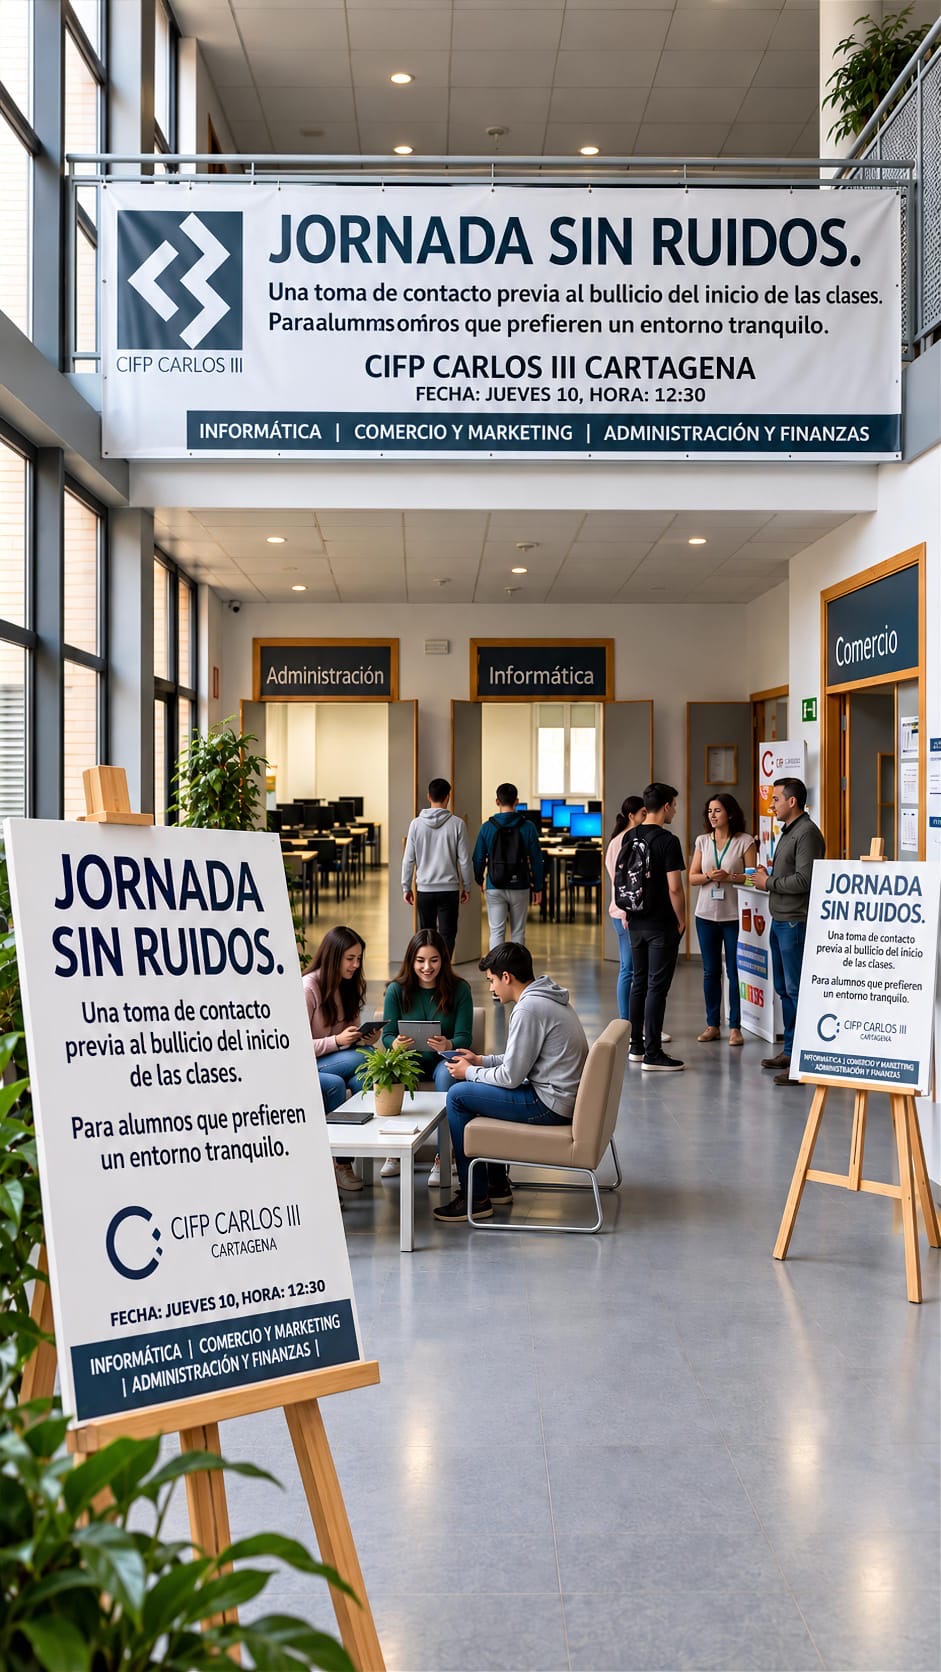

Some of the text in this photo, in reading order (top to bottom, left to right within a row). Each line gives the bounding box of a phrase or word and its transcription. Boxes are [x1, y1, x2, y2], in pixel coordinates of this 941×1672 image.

[269, 214, 861, 267] JORNADA SIN RUIDOS.
[269, 282, 882, 307] Una toma de contacto previa al bullicio del inicio de las clases.
[465, 319, 501, 337] que
[508, 314, 602, 337] prefieren
[609, 320, 634, 333] un
[640, 317, 723, 333] entorno
[728, 315, 829, 339] tranquilo.
[117, 356, 242, 373] CIFP CARLOS III
[365, 354, 756, 379] CIFP CARLOS III CARTAGENA
[416, 386, 705, 404] FECHA: JUEVES 10, HORA: 12:30
[200, 420, 322, 439] INFORMÁTICA
[355, 424, 447, 439] COMERCIO
[452, 425, 463, 440] Y
[469, 425, 572, 440] MARKETING
[604, 422, 759, 441] ADMINISTRACIÓN
[764, 426, 775, 441] Y
[781, 426, 869, 441] FINANZAS
[836, 625, 897, 666] Comercio
[267, 666, 383, 684] Administración
[490, 665, 593, 684] Informática
[55, 854, 264, 912] JORNADA
[825, 873, 922, 896] JORNADA
[820, 900, 925, 923] SIN RUIDOS.
[828, 930, 915, 944] Una toma de contacto
[52, 926, 284, 977] SIN RUIDOS.
[816, 944, 923, 958] previa al bullicio del inicio
[843, 957, 895, 969] de las clases.
[812, 975, 922, 991] Para alumnos que prefieren
[836, 991, 868, 1000] entorno
[870, 994, 909, 1004] tranquilo.
[82, 999, 270, 1023] Una toma de contacto
[844, 1020, 861, 1031] CIFP
[863, 1021, 897, 1034] CARLOS
[66, 1028, 289, 1064] previa al bullicio del inicio
[130, 1062, 242, 1087] de las clases.
[72, 1104, 306, 1139] Para alumnos que prefieren
[101, 1135, 289, 1170] un entorno tranquilo.
[171, 1204, 300, 1240] CIFP CARLOS III
[211, 1237, 277, 1258] CARTAGENA
[110, 1280, 325, 1327] FECHA: JUEVES 10, HORA: 12:30
[91, 1344, 182, 1375] INFORMÁTICA
[199, 1328, 262, 1353] COMERCIO
[264, 1326, 271, 1341] Y
[275, 1314, 340, 1339] MARKETING
[132, 1354, 239, 1393] ADMINISTRACIÓN
[241, 1354, 249, 1369] Y
[252, 1342, 311, 1367] FINANZAS
